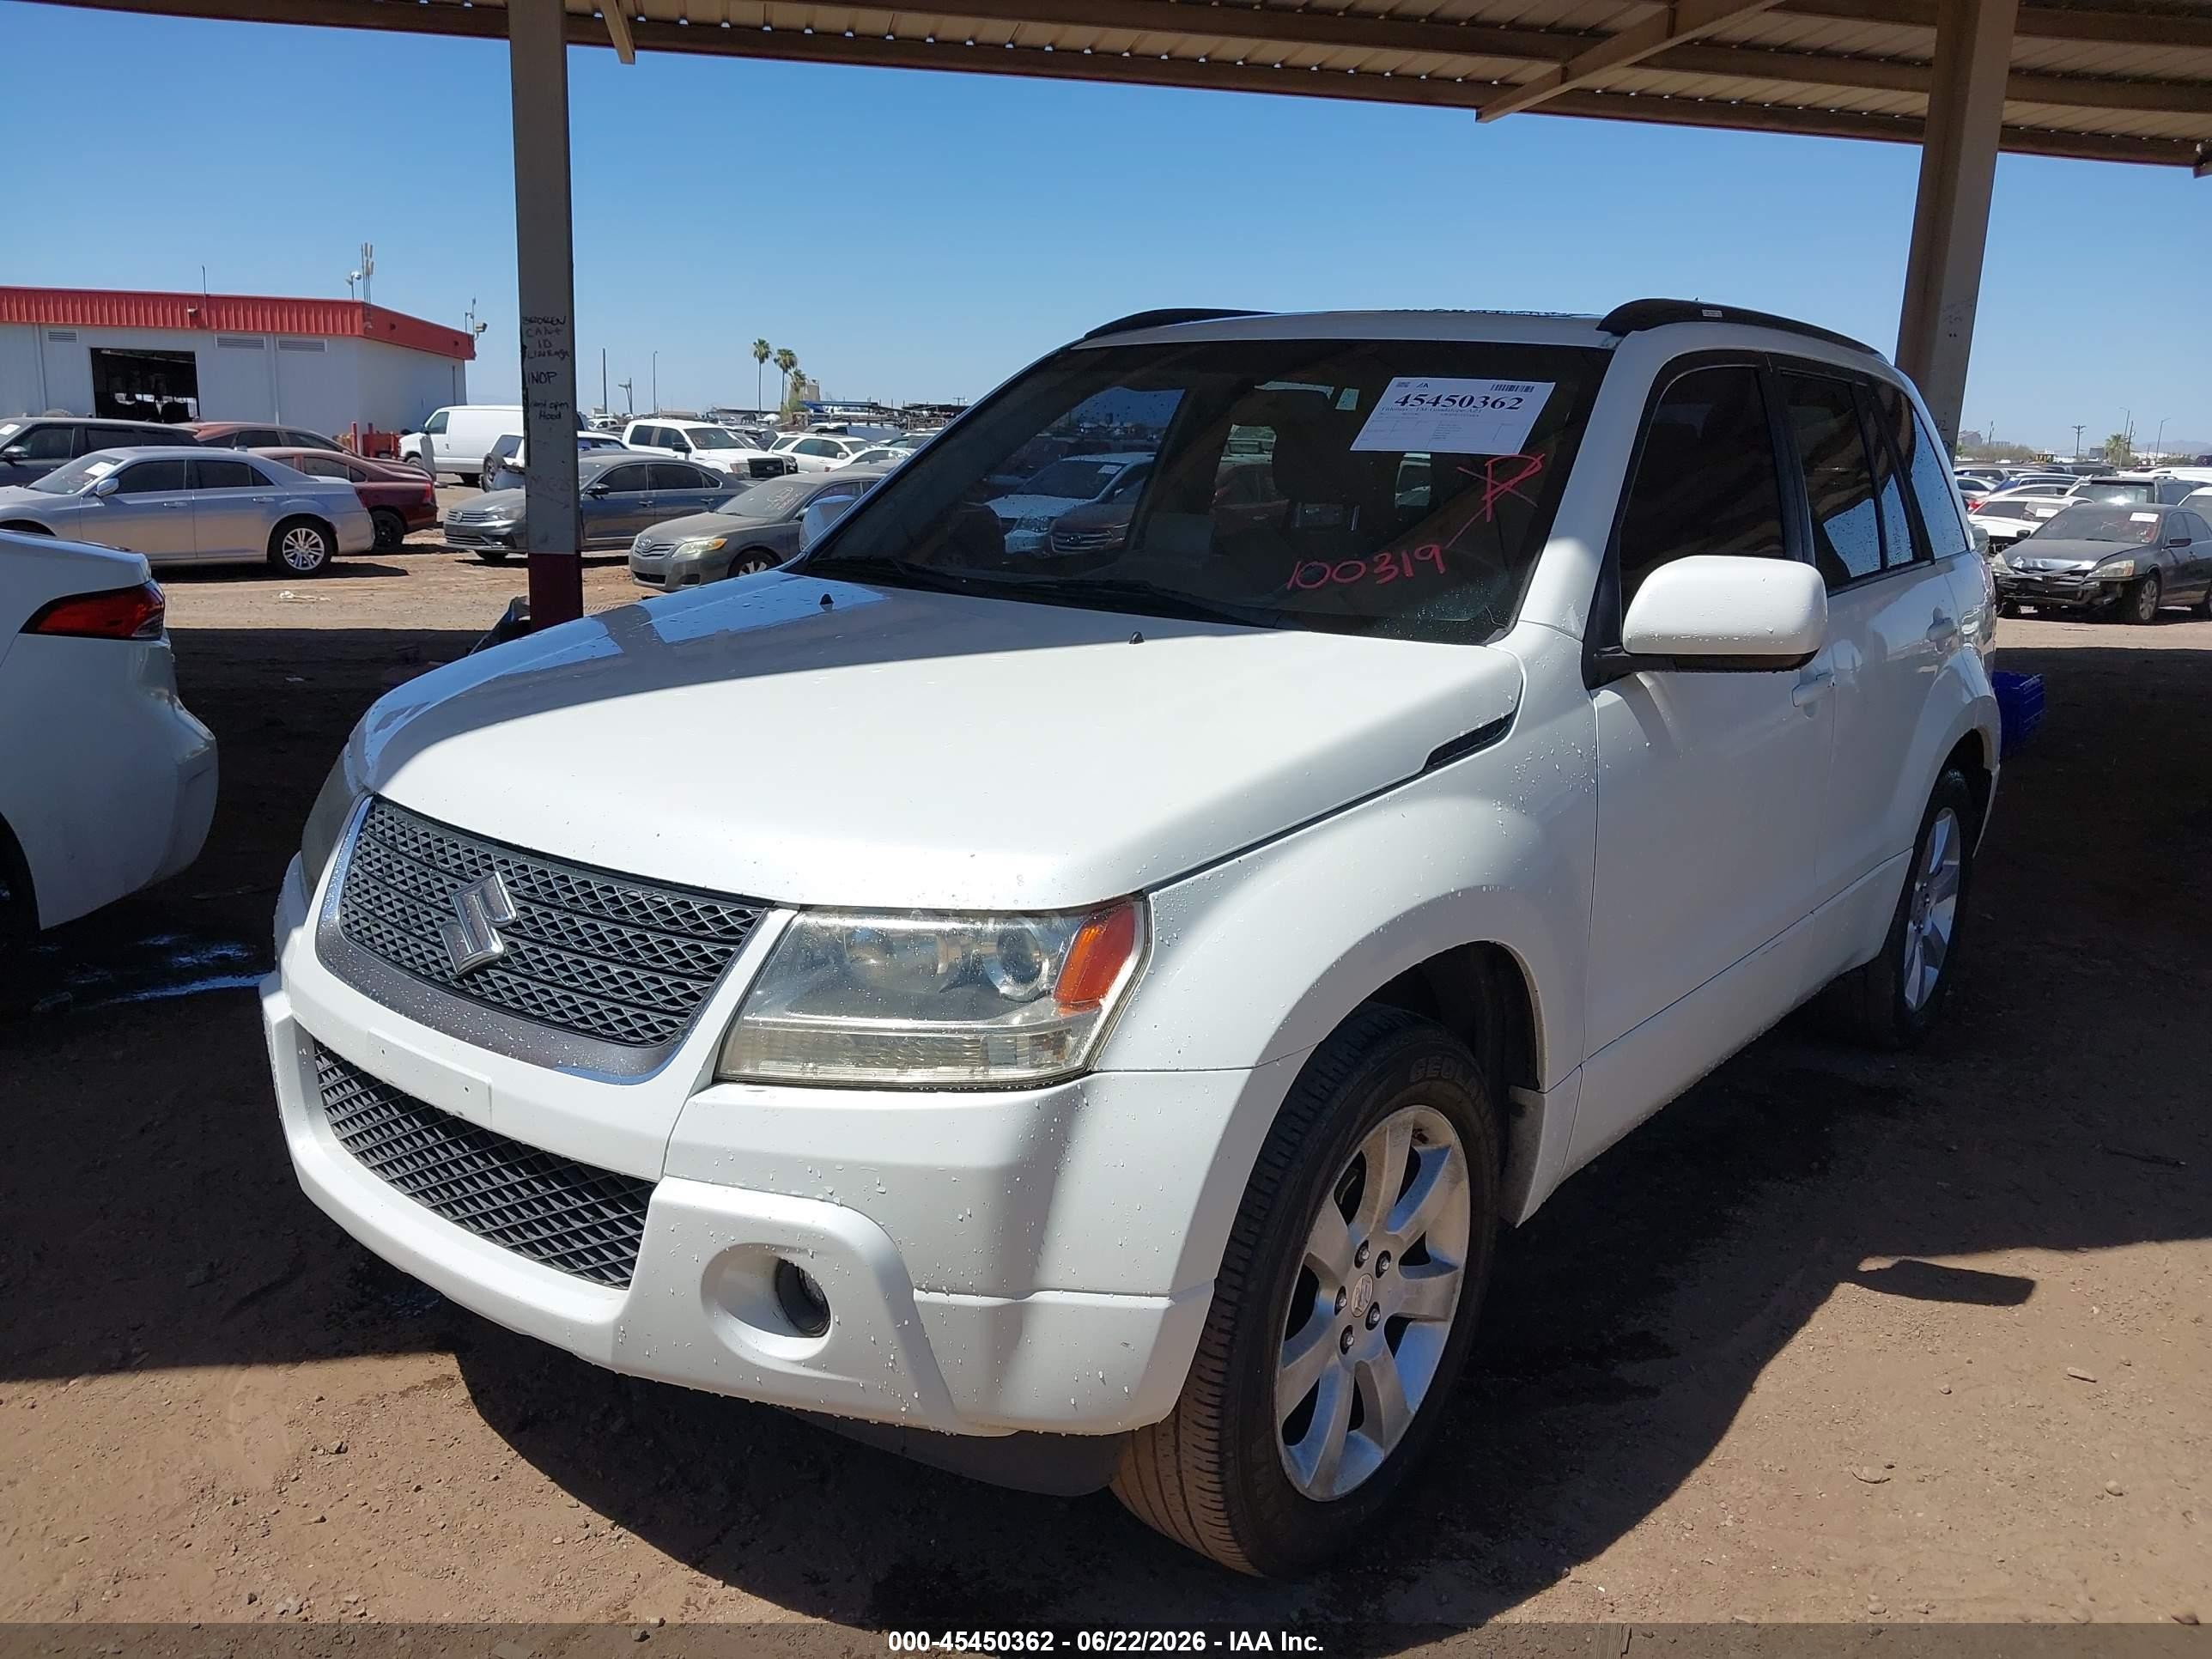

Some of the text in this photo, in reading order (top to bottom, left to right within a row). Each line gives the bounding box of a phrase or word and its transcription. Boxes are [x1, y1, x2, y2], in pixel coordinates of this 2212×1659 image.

[527, 371, 557, 385] INOP
[1394, 393, 1524, 410] 45450362
[1287, 544, 1446, 591] 100319
